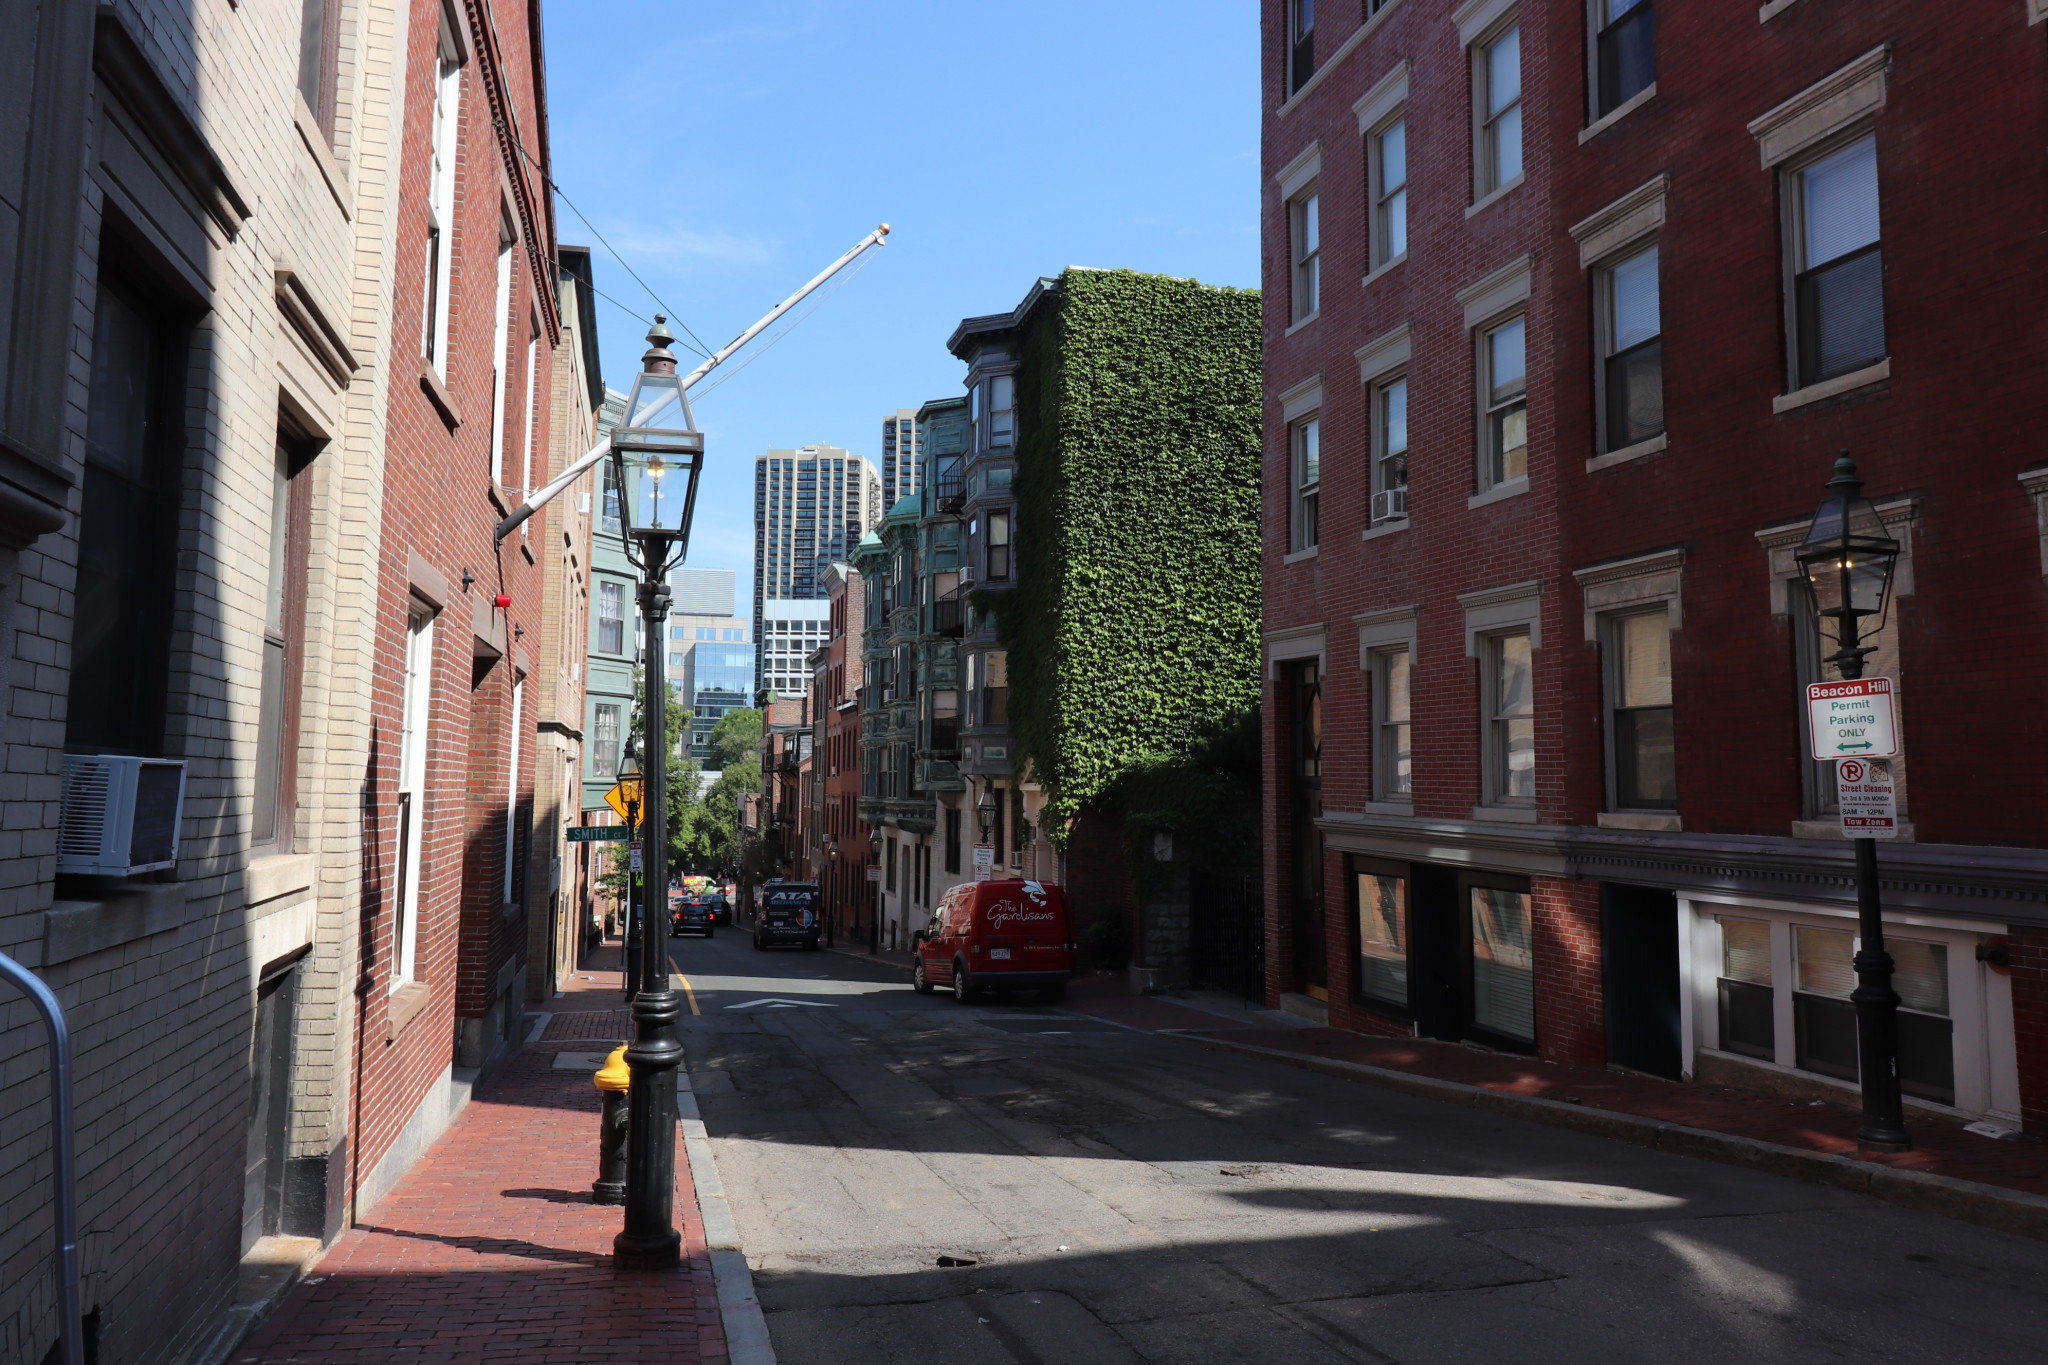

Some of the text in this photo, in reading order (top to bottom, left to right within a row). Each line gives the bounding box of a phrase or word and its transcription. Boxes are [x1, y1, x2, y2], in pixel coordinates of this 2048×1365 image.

[1811, 681, 1889, 698] Beacon Hill
[1831, 700, 1870, 711] Permit
[1830, 714, 1875, 725] Parking
[1839, 728, 1866, 738] ONLY
[1864, 785, 1891, 793] Cleaning
[574, 828, 607, 840] SMITH
[1000, 900, 1017, 912] The
[987, 903, 1054, 929] Gardisans
